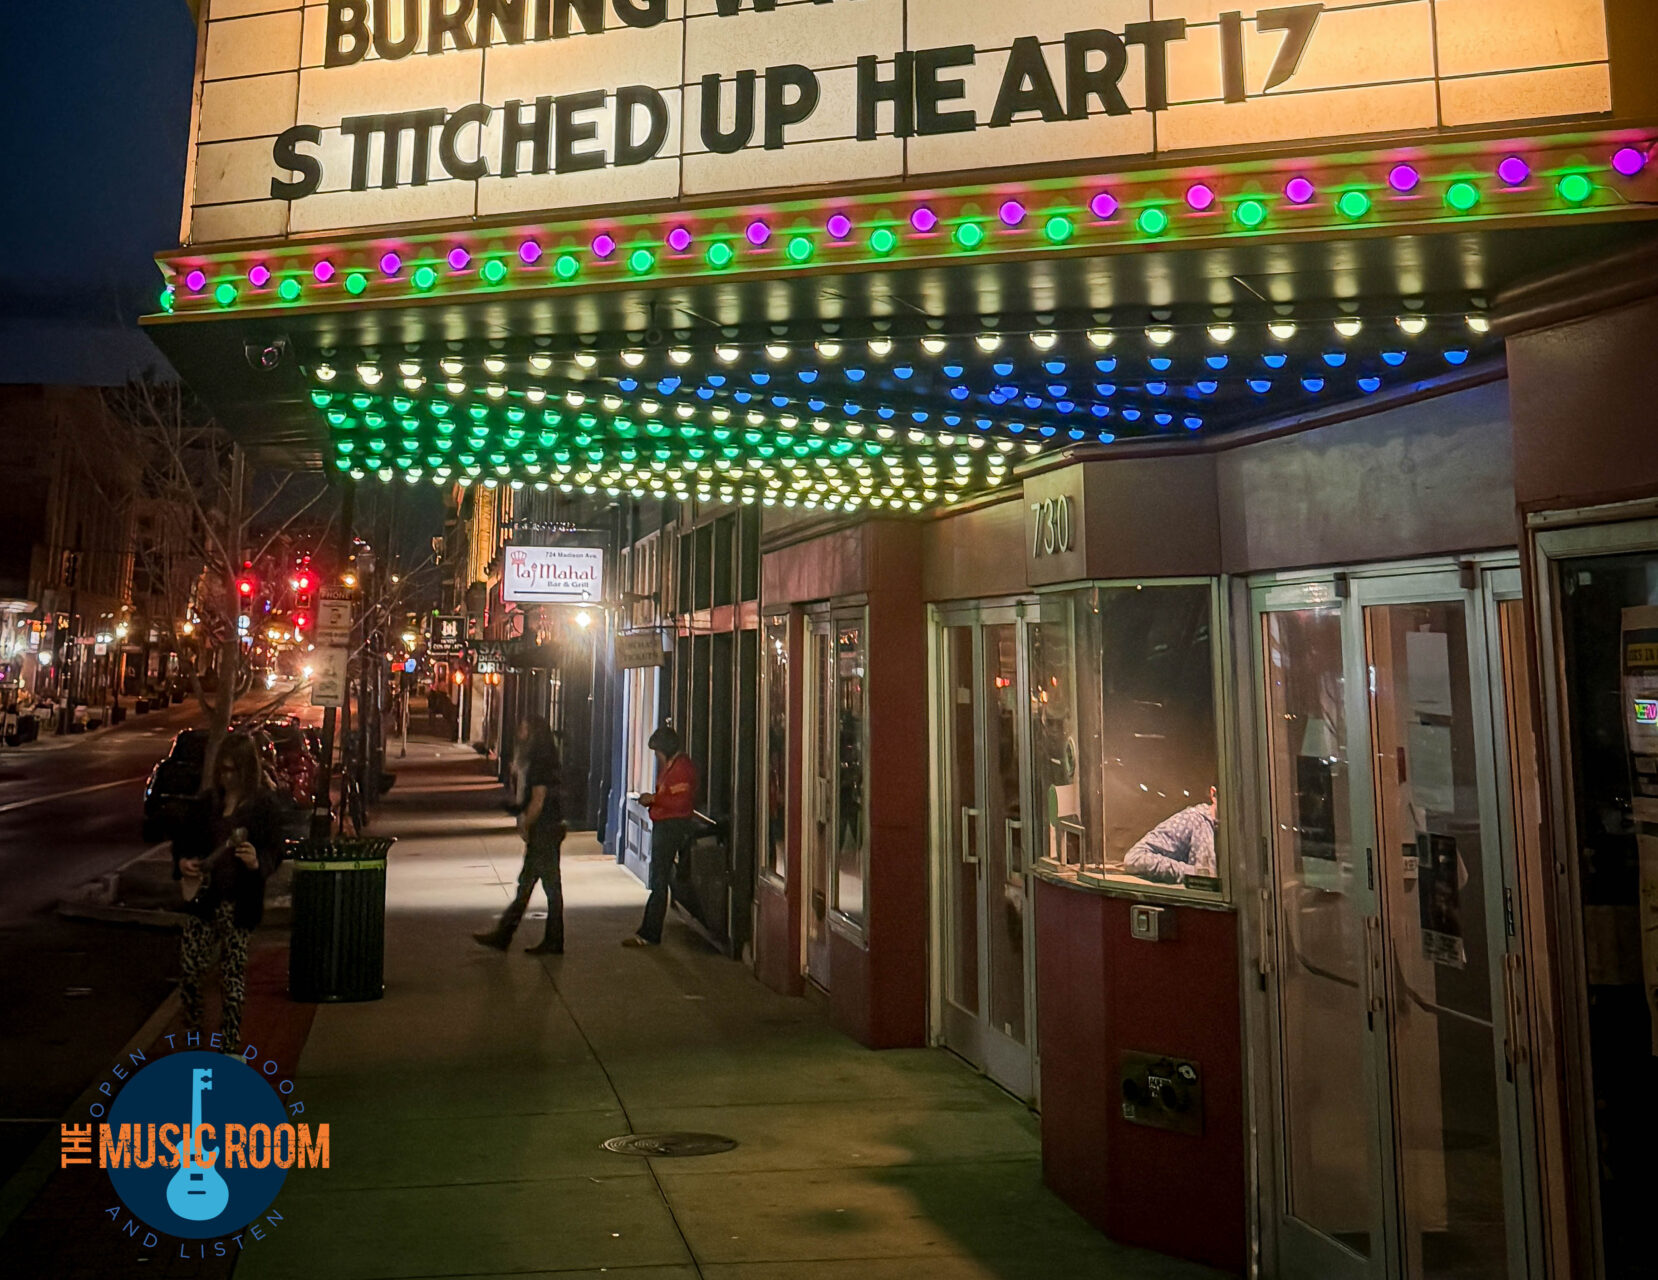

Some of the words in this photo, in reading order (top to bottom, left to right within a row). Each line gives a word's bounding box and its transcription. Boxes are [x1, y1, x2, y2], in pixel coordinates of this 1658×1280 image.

[270, 84, 671, 201] STITCHED
[700, 64, 821, 154] UP
[856, 17, 1187, 141] HEART
[1219, 2, 1326, 104] 17
[1031, 494, 1069, 558] 730
[511, 560, 538, 588] Taj
[539, 563, 598, 580] Mahal
